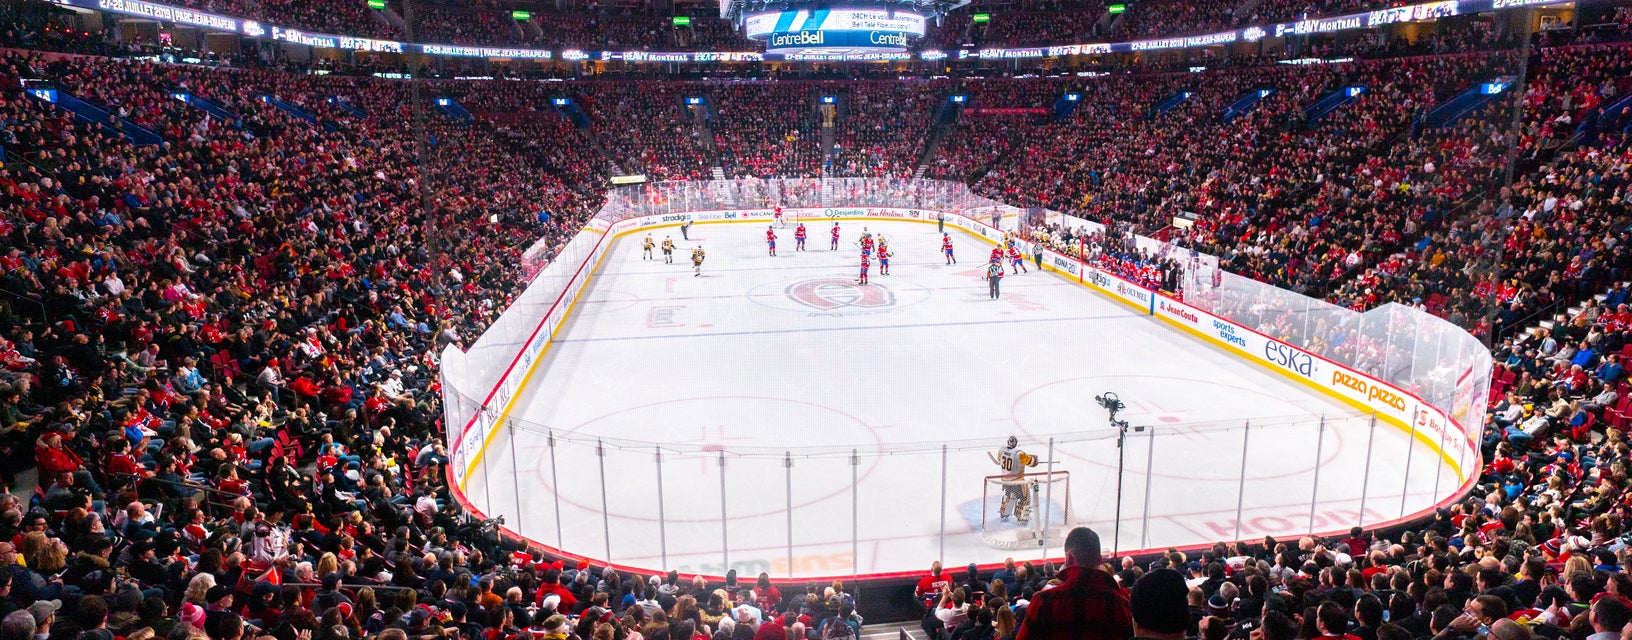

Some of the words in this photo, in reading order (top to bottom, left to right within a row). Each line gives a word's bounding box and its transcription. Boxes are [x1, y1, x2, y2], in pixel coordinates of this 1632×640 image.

[125, 1, 153, 18] JUILLET
[154, 7, 171, 20] 2019
[176, 9, 192, 23] PARC
[192, 13, 236, 31] JEAN-DRAPEAU
[1294, 20, 1318, 34] HEAVY
[441, 46, 463, 56] JUILLET
[484, 49, 500, 58] PARC
[500, 49, 551, 59] JEAN-DRAPEAU
[623, 52, 647, 61] HEAVY
[979, 50, 1004, 58] HEAVY
[1488, 83, 1502, 94] Bell
[662, 214, 687, 223] stradigi
[834, 209, 864, 218] Desjardins
[866, 209, 879, 218] Tim
[879, 209, 904, 219] Hortons
[1054, 256, 1069, 269] RONA
[1126, 286, 1149, 303] OLYMEL
[1212, 319, 1235, 335] sports
[1219, 330, 1247, 348] experts
[1264, 339, 1313, 378] eska
[1332, 370, 1367, 393] pizza
[1367, 385, 1407, 412] pizza
[1001, 456, 1013, 472] 30
